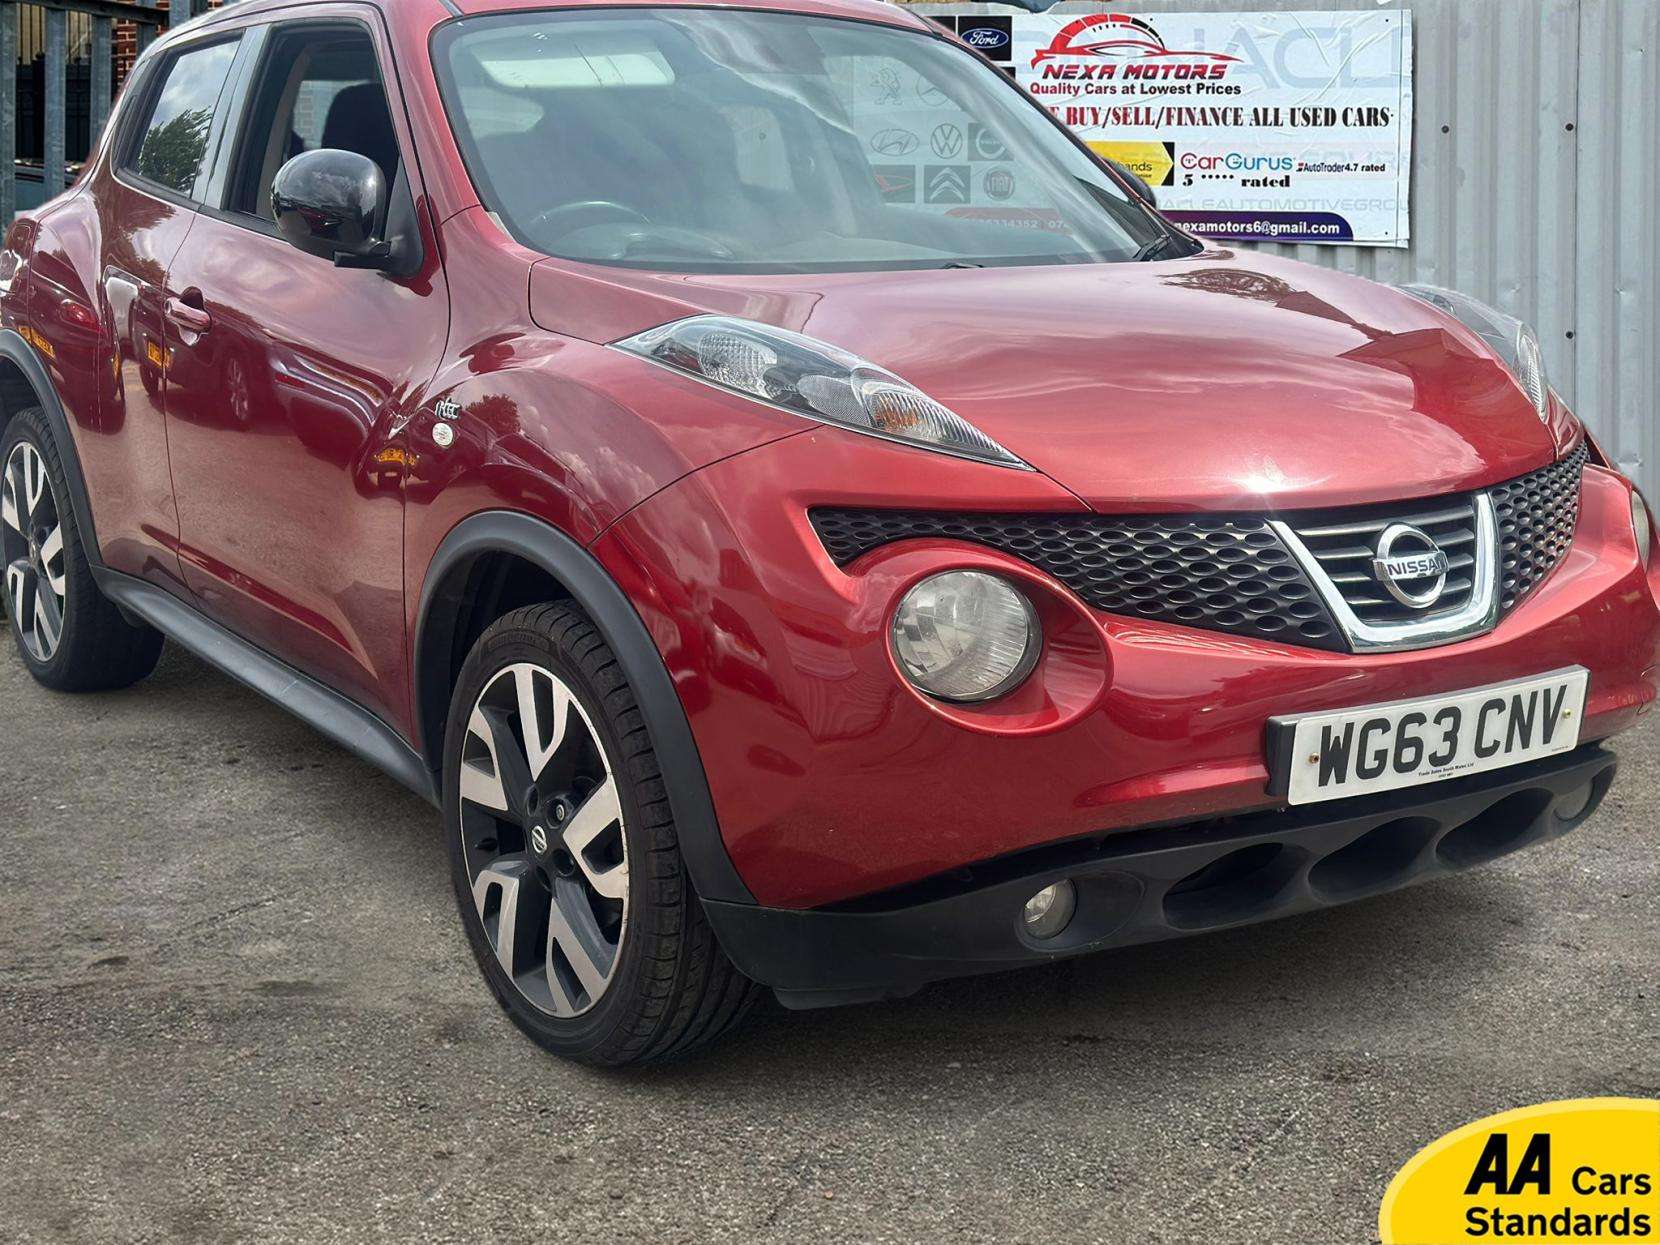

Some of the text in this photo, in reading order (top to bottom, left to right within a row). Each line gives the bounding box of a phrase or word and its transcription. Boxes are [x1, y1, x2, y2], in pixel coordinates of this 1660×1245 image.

[969, 30, 1000, 46] Ford
[1042, 64, 1228, 80] NEXA MOTORS
[1030, 82, 1242, 97] Quality Cars at Lowest Prices
[1066, 106, 1244, 129] BUY/SELL/FINANCE
[1249, 106, 1283, 127] ALL
[1289, 106, 1337, 127] USED
[1342, 106, 1390, 127] CARS
[1180, 153, 1293, 171] CarGurus
[1361, 163, 1386, 172] rated
[1182, 173, 1291, 187] 5 rated
[1174, 220, 1340, 235] nexamotors6@gmail.com
[1387, 554, 1447, 576] NISSAN
[1318, 685, 1568, 787] WG63 CNV
